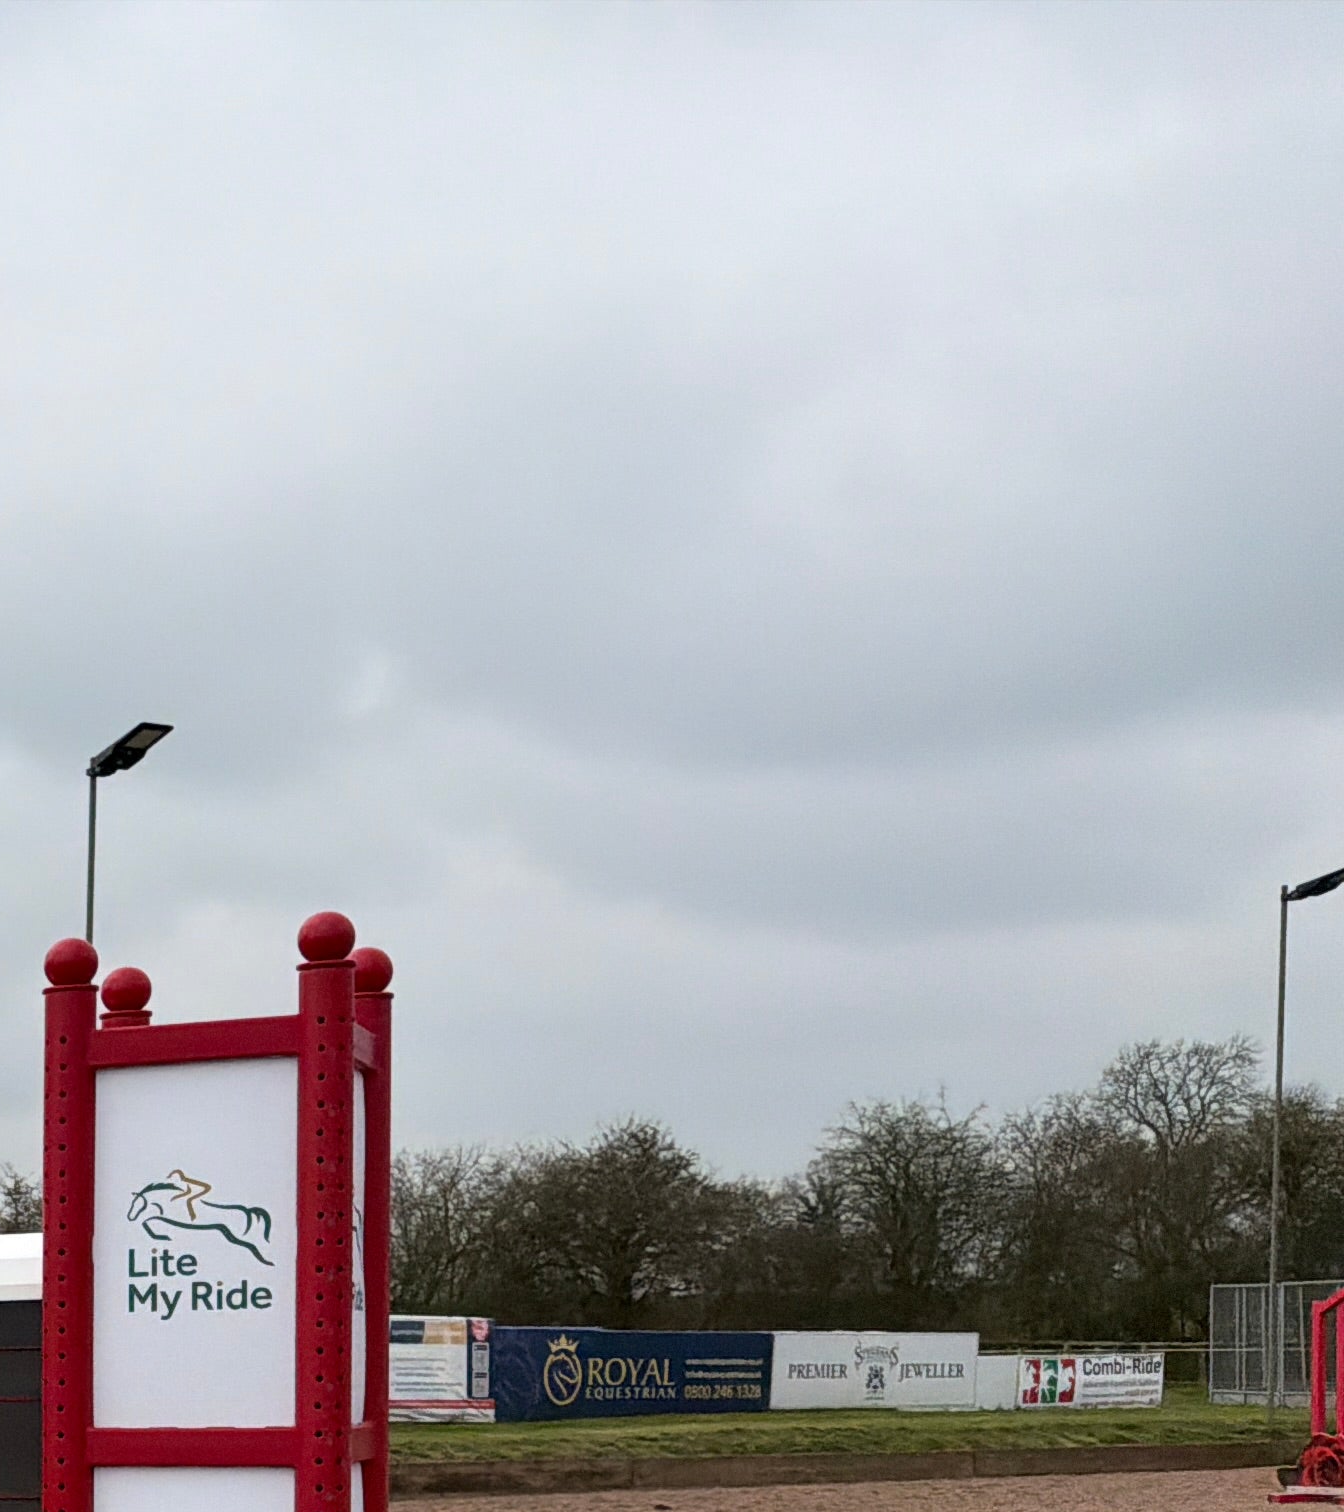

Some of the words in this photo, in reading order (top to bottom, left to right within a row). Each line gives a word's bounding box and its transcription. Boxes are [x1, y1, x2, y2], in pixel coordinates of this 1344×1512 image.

[128, 1247, 198, 1278] Lite
[128, 1283, 183, 1321] My
[191, 1280, 273, 1311] Ride
[587, 1357, 676, 1387] ROYAL
[787, 1363, 848, 1380] PREMIER
[898, 1363, 965, 1382] JEWELLER
[1082, 1357, 1162, 1376] Combi-Ride
[585, 1386, 676, 1400] EQUESTRIAN
